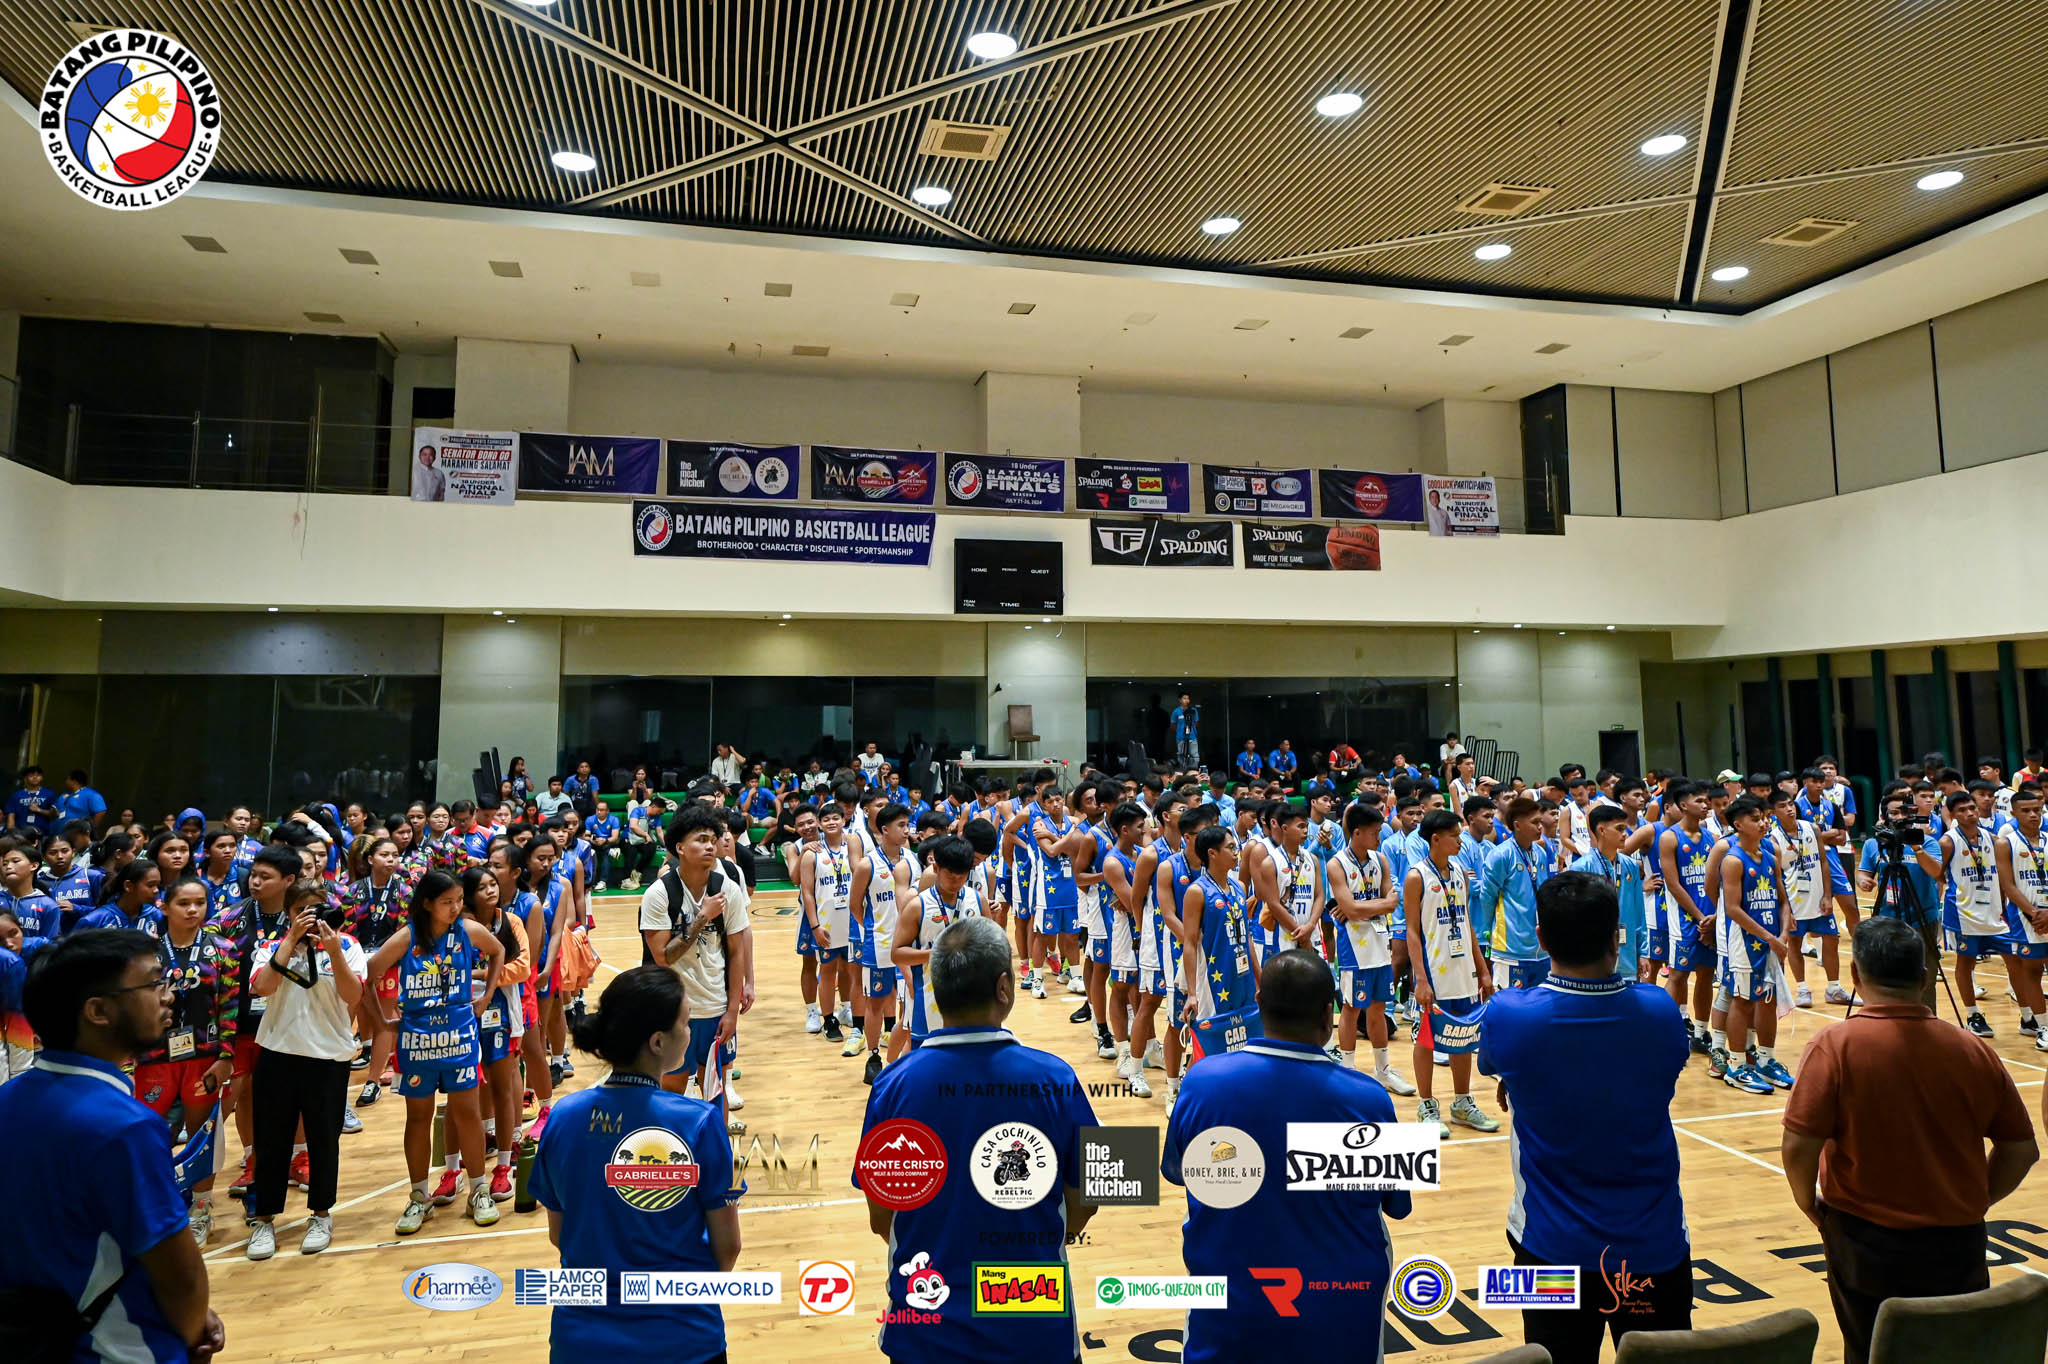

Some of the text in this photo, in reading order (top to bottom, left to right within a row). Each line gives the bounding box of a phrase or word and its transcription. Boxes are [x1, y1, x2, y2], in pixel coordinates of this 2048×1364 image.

[443, 448, 476, 459] SENATOR
[499, 451, 510, 461] GO
[441, 459, 510, 470] MARAMING SALAMAT
[680, 461, 692, 470] the
[680, 469, 698, 479] meat
[988, 469, 1060, 478] NATIONAL
[680, 479, 705, 488] kitchen
[986, 480, 1061, 494] FINALS
[1078, 476, 1113, 488] SPALDING
[1454, 480, 1492, 491] PARTICIPANTS!
[1270, 502, 1304, 510] MEGAWORLD
[675, 514, 930, 543] BATANG PILIPINO BASKETBALL LEAGUE
[1253, 529, 1303, 543] SPALDING
[697, 540, 914, 556] BROTHERHOOD CHARACTER DISCIPLINE SPORTSMANSHIP
[1160, 539, 1228, 556] SPALDING
[1296, 902, 1306, 914] 77
[1761, 911, 1774, 925] 15
[1226, 919, 1246, 938] CR
[494, 1032, 503, 1048] 6
[1225, 1026, 1247, 1045] CAR
[409, 1043, 472, 1061] PANGASINAN
[456, 1066, 476, 1083] 24
